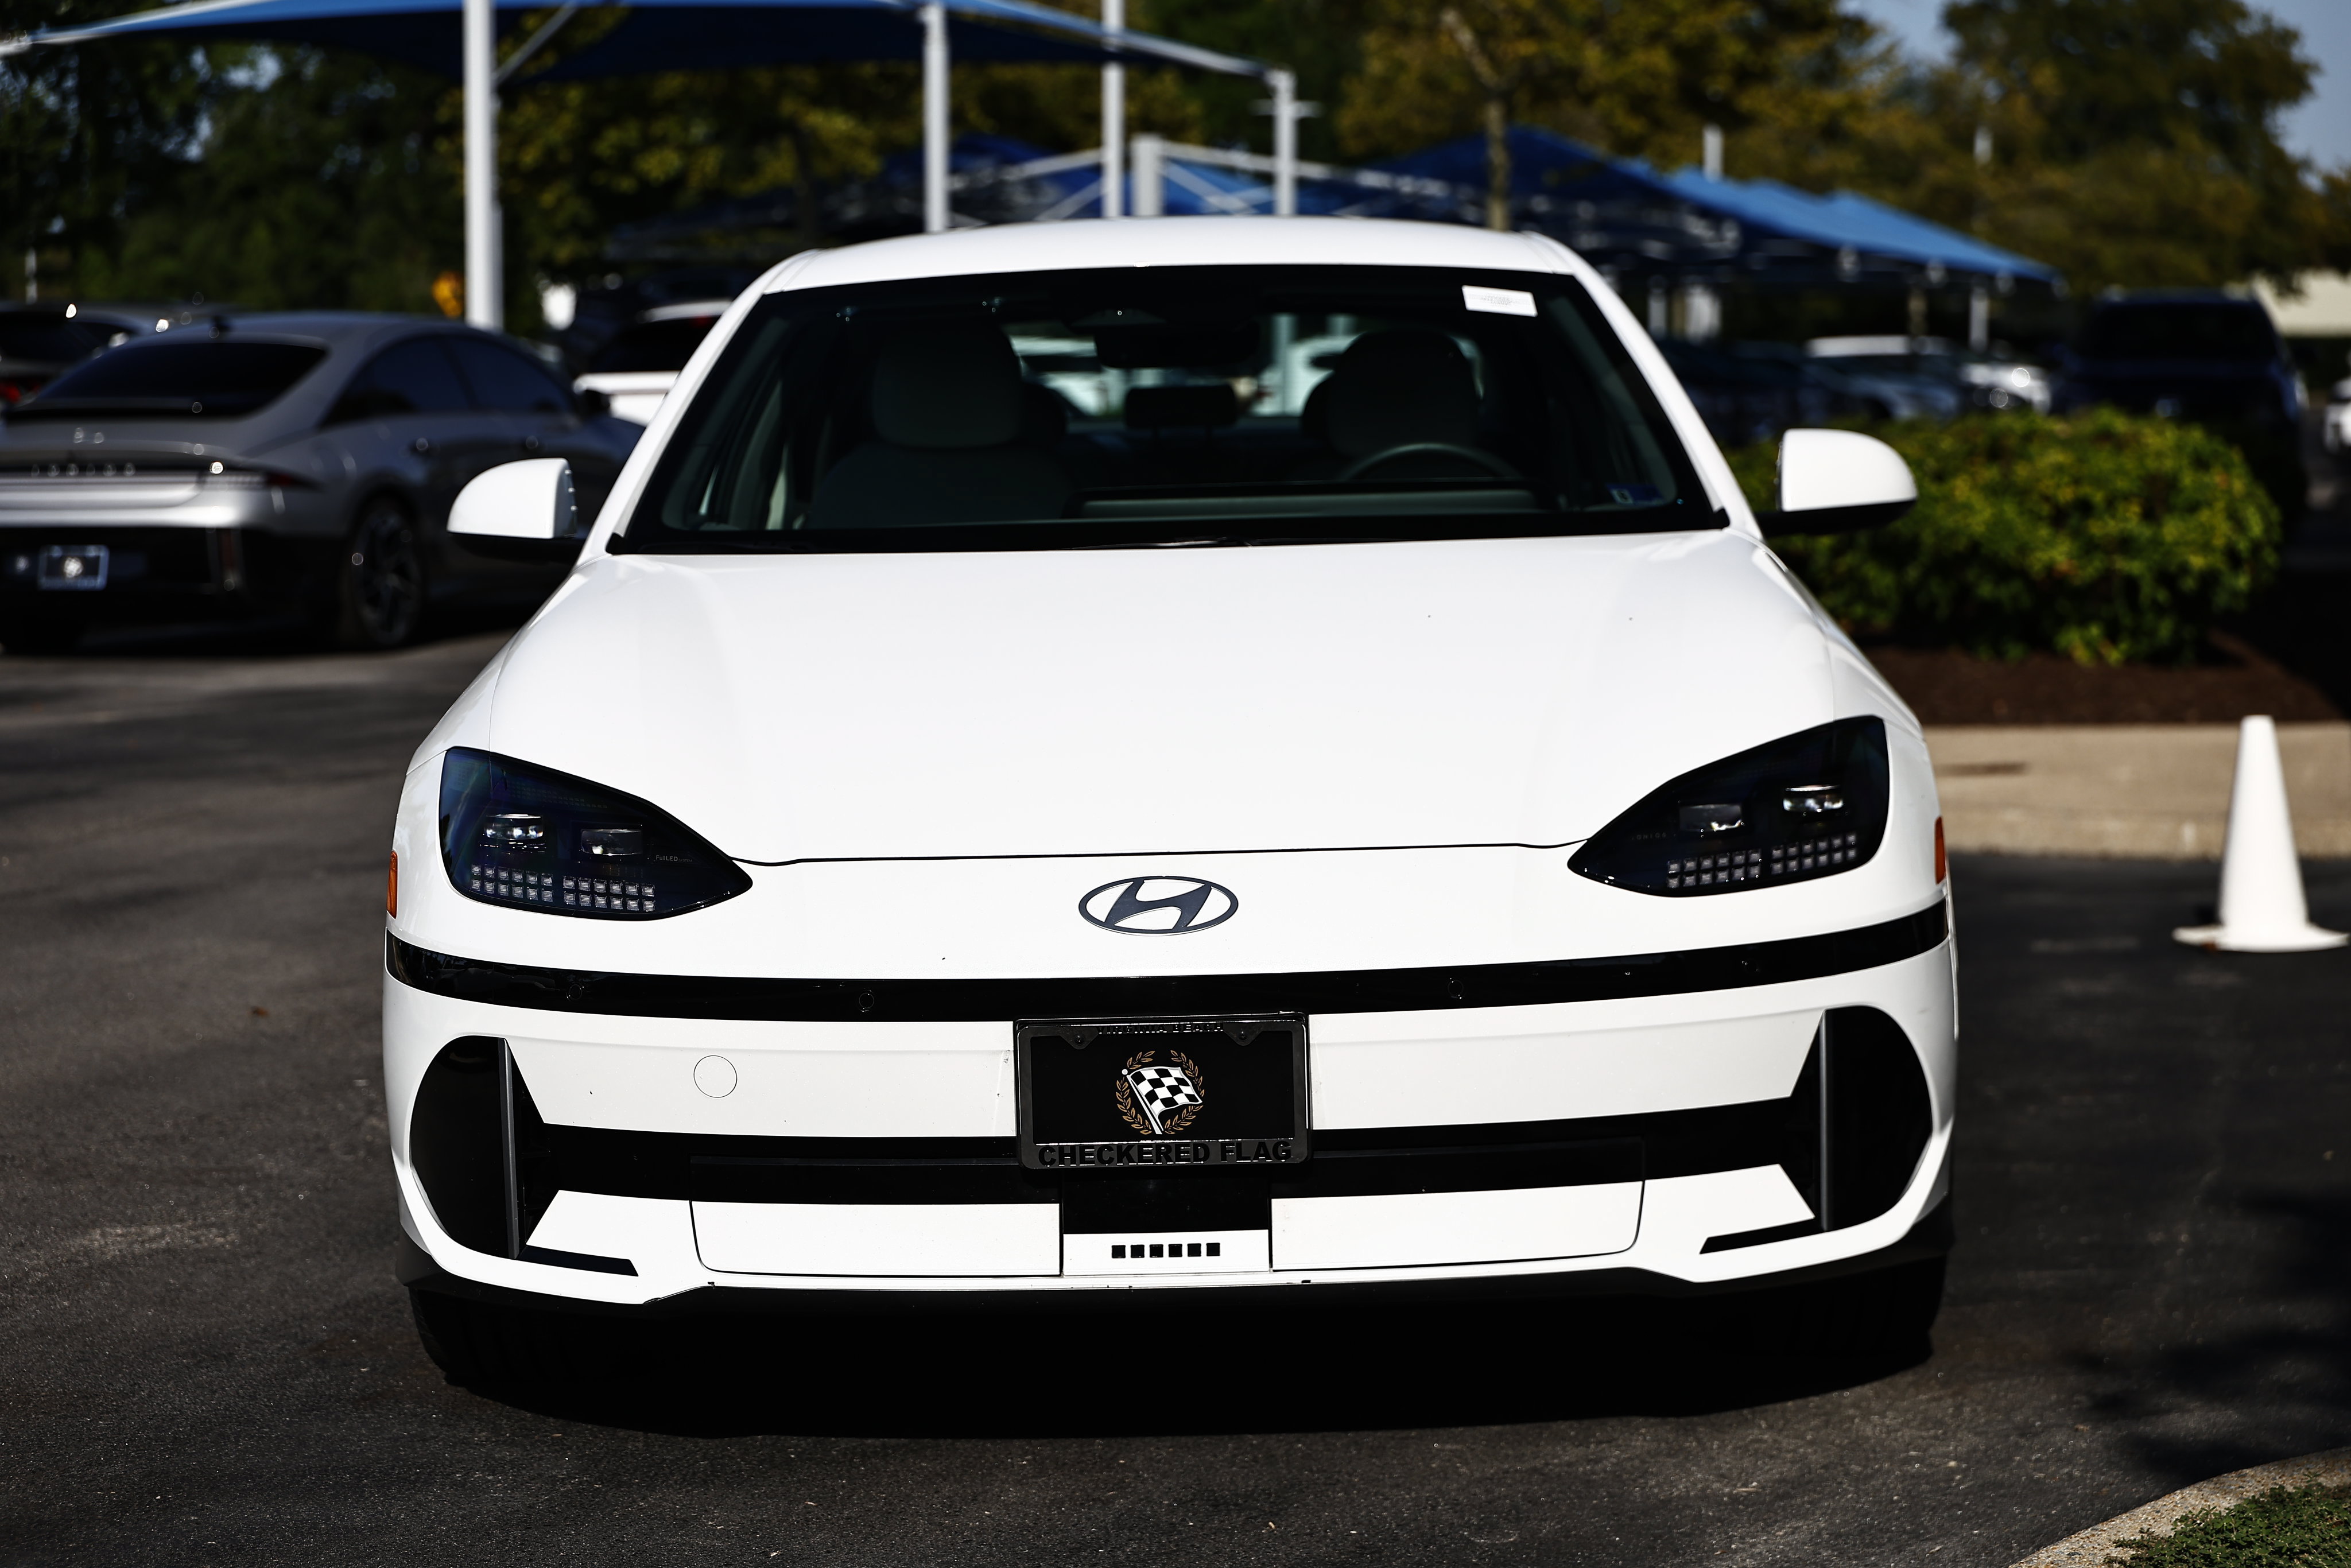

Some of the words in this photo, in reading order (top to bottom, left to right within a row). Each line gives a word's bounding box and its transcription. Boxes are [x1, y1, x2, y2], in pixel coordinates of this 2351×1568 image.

[1096, 1024, 1167, 1034] VIRGINIA
[1172, 1023, 1224, 1033] BEACH
[1038, 1143, 1210, 1167] CHECKERED
[1220, 1140, 1292, 1164] FLAG
